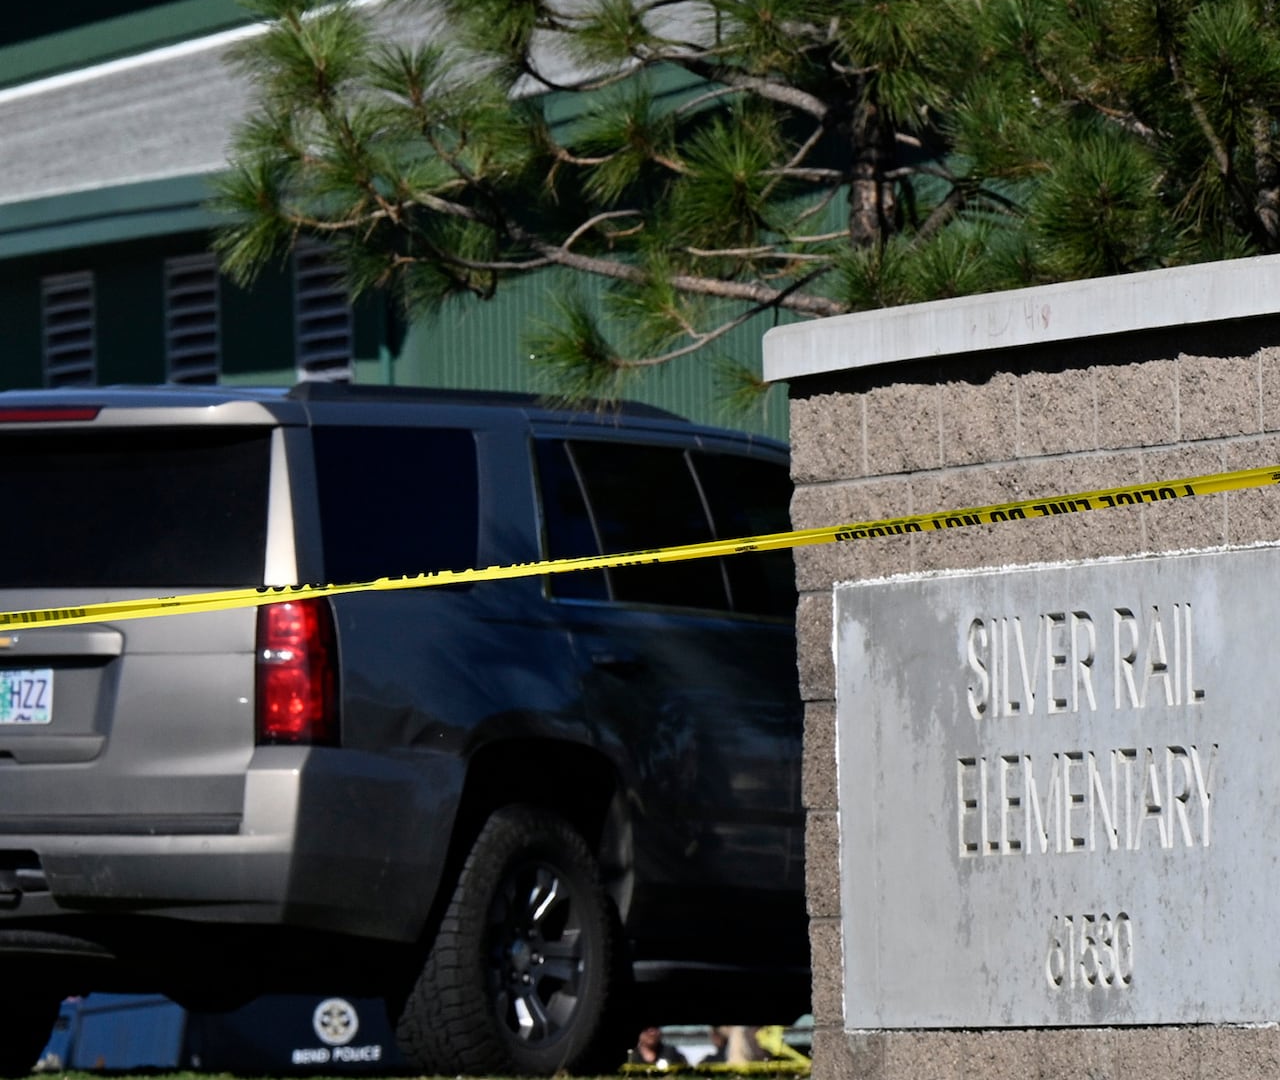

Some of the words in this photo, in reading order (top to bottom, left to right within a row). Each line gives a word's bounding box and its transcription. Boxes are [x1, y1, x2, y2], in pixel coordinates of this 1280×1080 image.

[10, 679, 48, 709] HZZ
[967, 610, 1097, 720] SILVER
[1113, 602, 1206, 710] RAIL
[957, 743, 1219, 858] ELEMENTARY
[1046, 911, 1133, 991] 61530
[292, 1048, 330, 1064] BEND
[332, 1045, 382, 1062] POLICE
